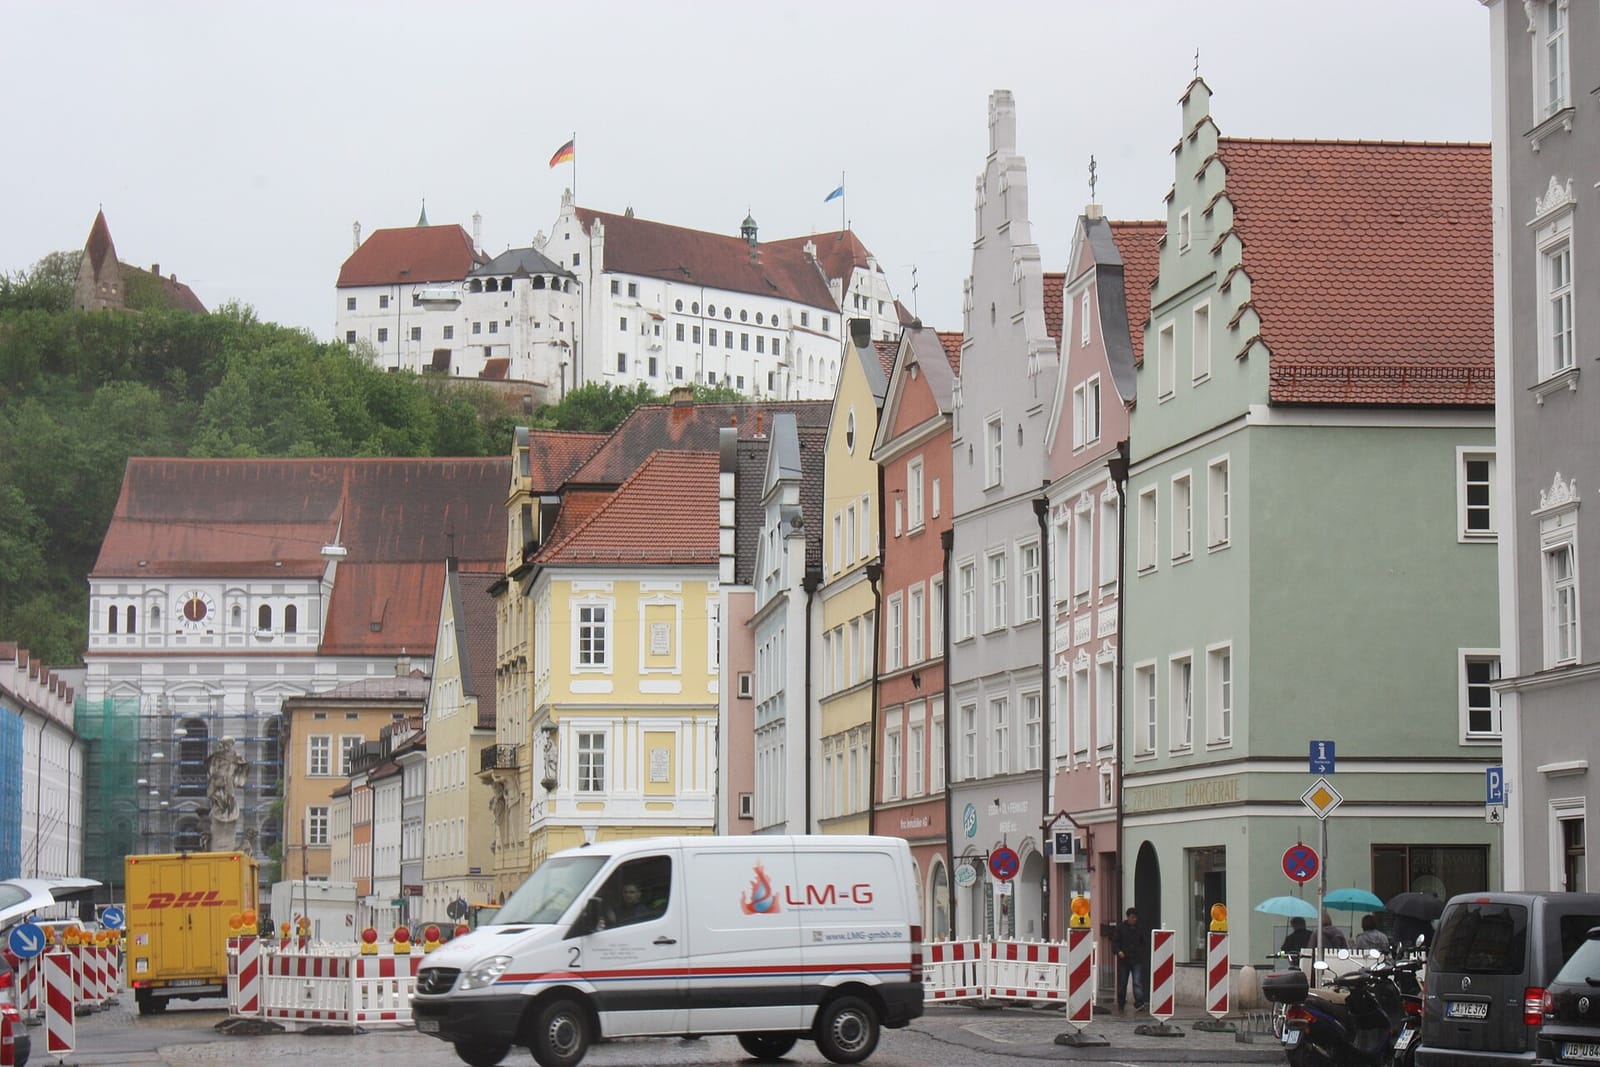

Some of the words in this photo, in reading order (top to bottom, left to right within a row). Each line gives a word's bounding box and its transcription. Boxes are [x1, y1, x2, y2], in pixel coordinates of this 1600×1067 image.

[1490, 771, 1500, 799] P
[146, 891, 224, 909] DHL
[785, 884, 873, 905] LM-G
[568, 947, 581, 968] 2
